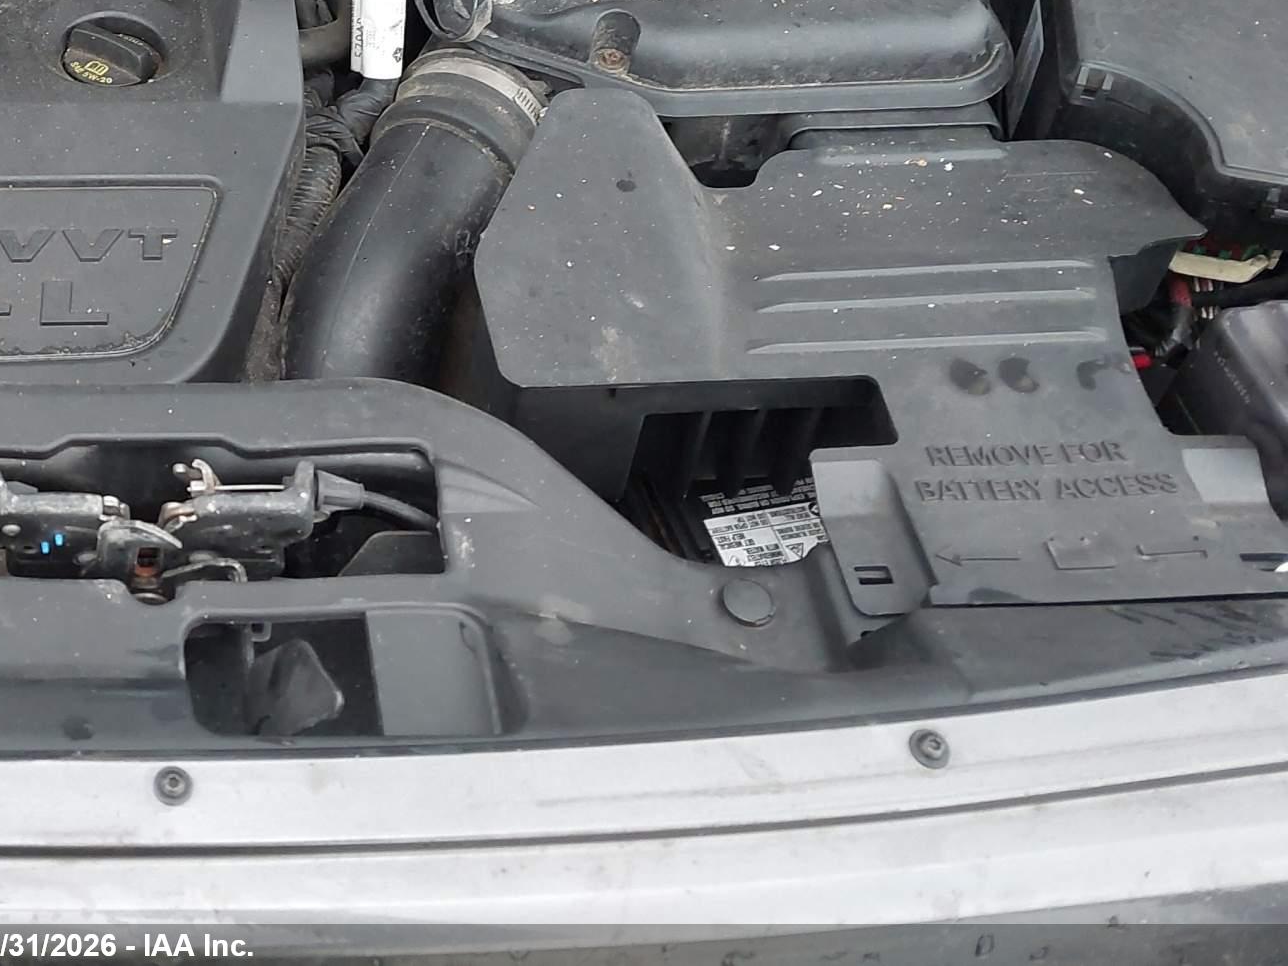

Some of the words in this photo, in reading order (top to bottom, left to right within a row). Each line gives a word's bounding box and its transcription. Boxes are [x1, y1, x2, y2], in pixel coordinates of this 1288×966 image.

[81, 71, 113, 84] 5W-20
[924, 443, 1059, 468] REMOVE
[1059, 440, 1130, 465] FOR
[913, 477, 1045, 502] BATTERY
[1055, 472, 1179, 501] ACCESS
